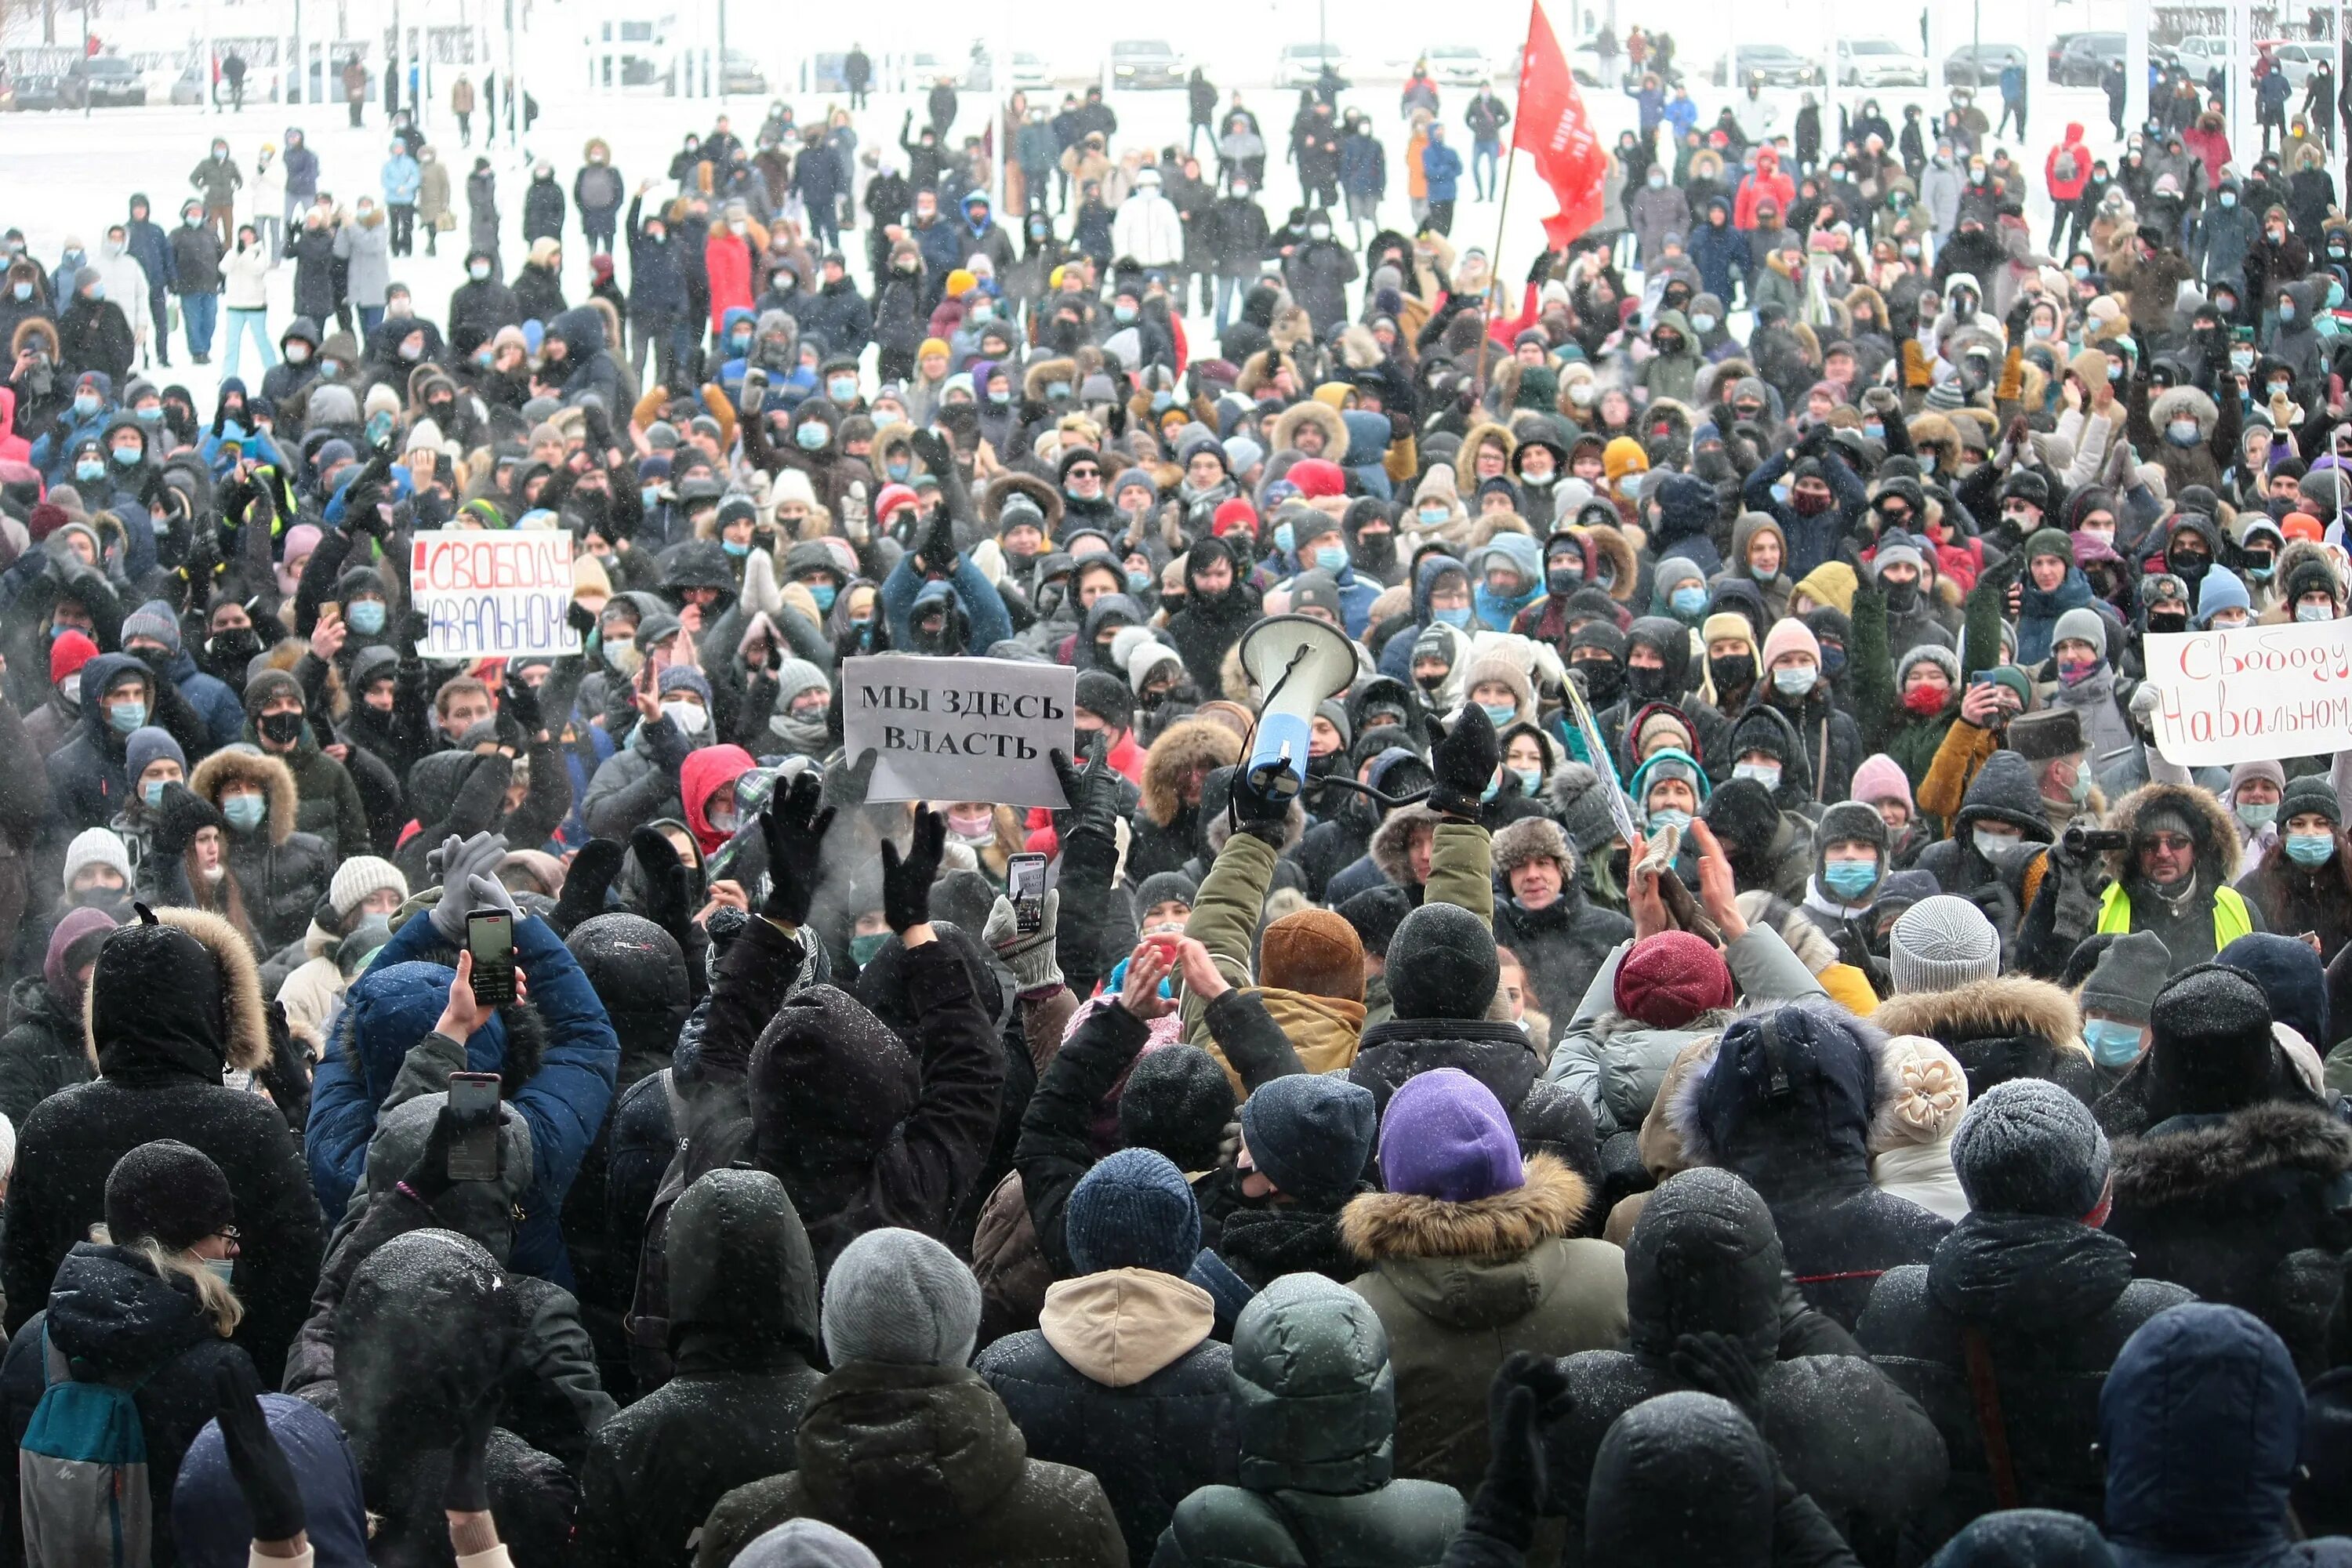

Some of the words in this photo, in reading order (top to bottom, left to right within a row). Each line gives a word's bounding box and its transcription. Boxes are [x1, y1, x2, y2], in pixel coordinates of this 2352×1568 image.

[2180, 632, 2349, 681] Свободу
[861, 685, 931, 712] МЫ
[942, 689, 1064, 720] ЗДЕСЬ
[2159, 680, 2352, 744] Навальном
[883, 726, 1037, 760] ВЛАСТЬ
